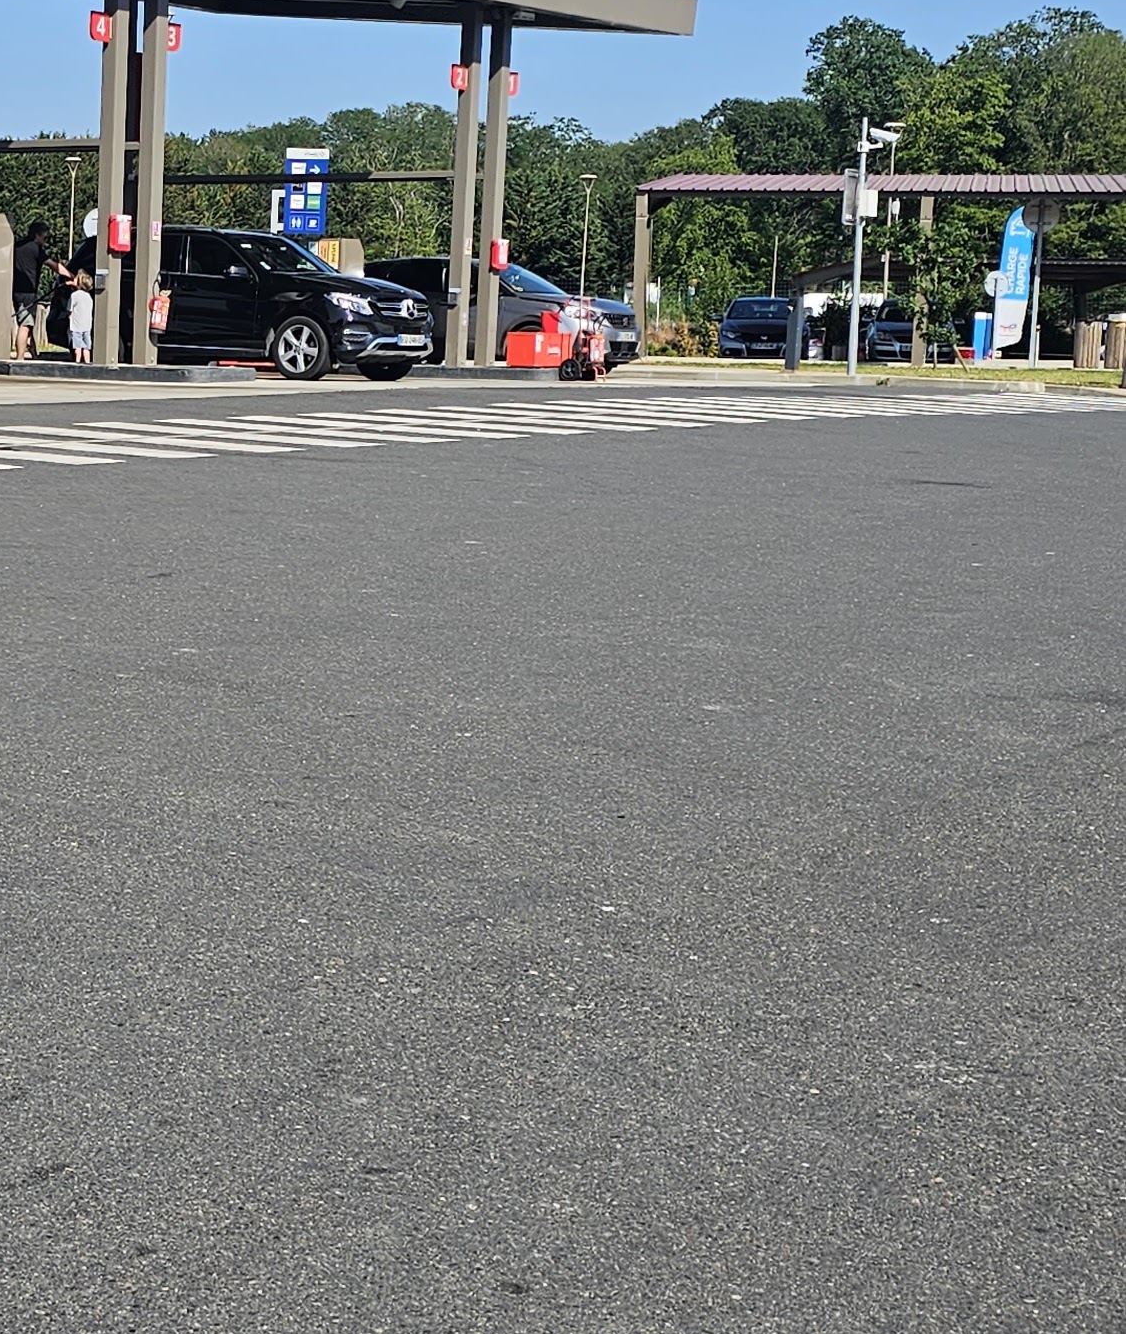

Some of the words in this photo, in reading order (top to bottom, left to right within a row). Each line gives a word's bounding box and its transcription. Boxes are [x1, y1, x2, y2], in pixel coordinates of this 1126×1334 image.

[96, 16, 106, 37] 4
[168, 26, 177, 47] 3
[456, 68, 463, 86] 2
[508, 75, 515, 92] 1
[1006, 247, 1019, 294] CHARGE
[1015, 253, 1029, 295] RAPIDE
